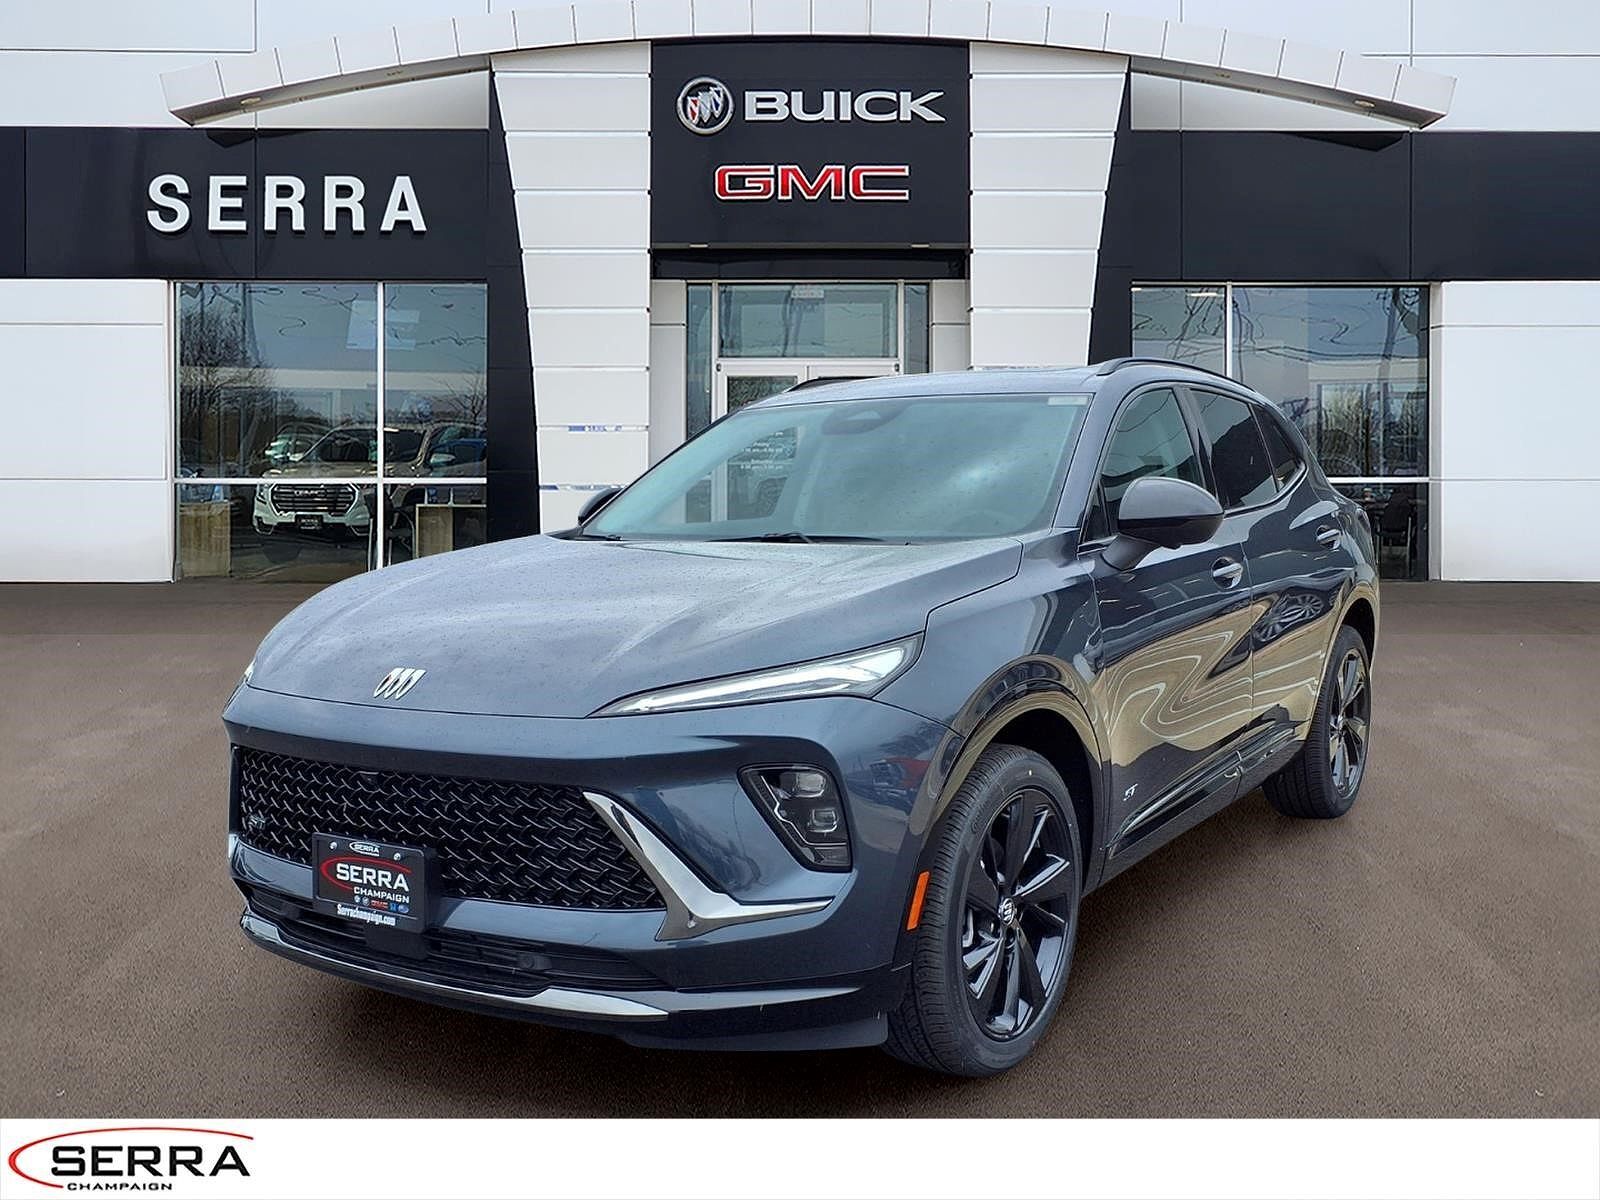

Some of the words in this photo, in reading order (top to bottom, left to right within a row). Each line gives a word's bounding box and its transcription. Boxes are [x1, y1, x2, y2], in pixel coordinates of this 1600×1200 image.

[744, 90, 946, 122] BUICK
[714, 164, 909, 201] GMC
[146, 173, 428, 233] SERRA
[354, 844, 380, 853] SERRA
[336, 863, 410, 892] SERRA
[353, 886, 410, 904] CHAMPAIGN
